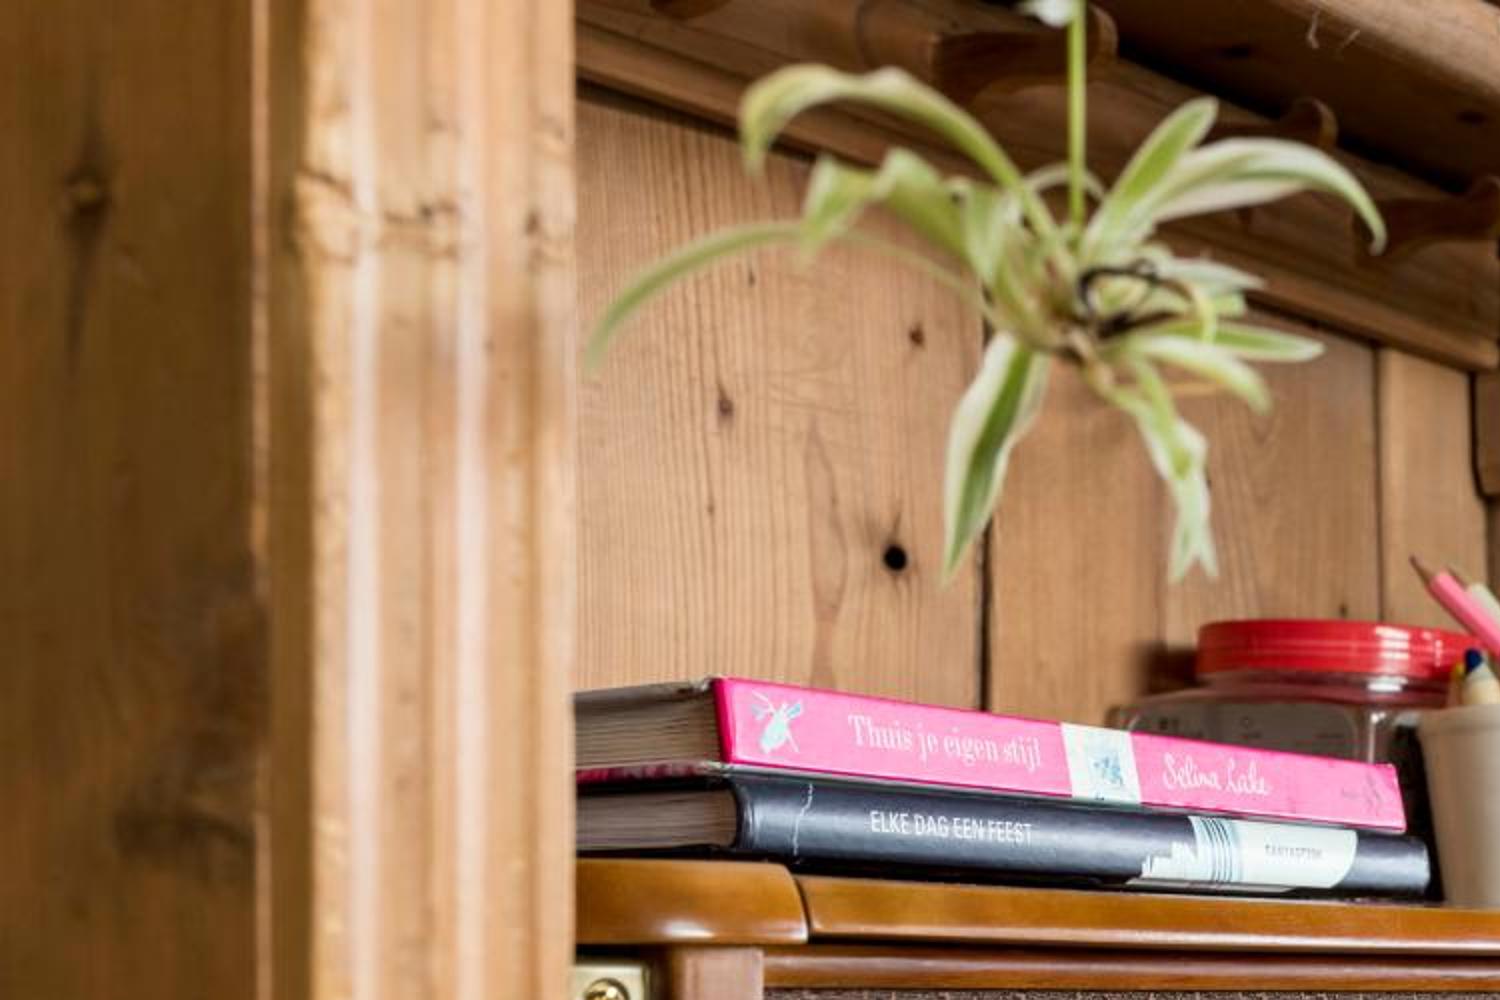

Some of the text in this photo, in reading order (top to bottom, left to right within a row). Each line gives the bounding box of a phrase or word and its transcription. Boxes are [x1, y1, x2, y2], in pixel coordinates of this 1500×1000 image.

[848, 713, 1042, 774] Thuis je eigen stijl
[869, 810, 1033, 845] ELKE DAG EEN FEEST
